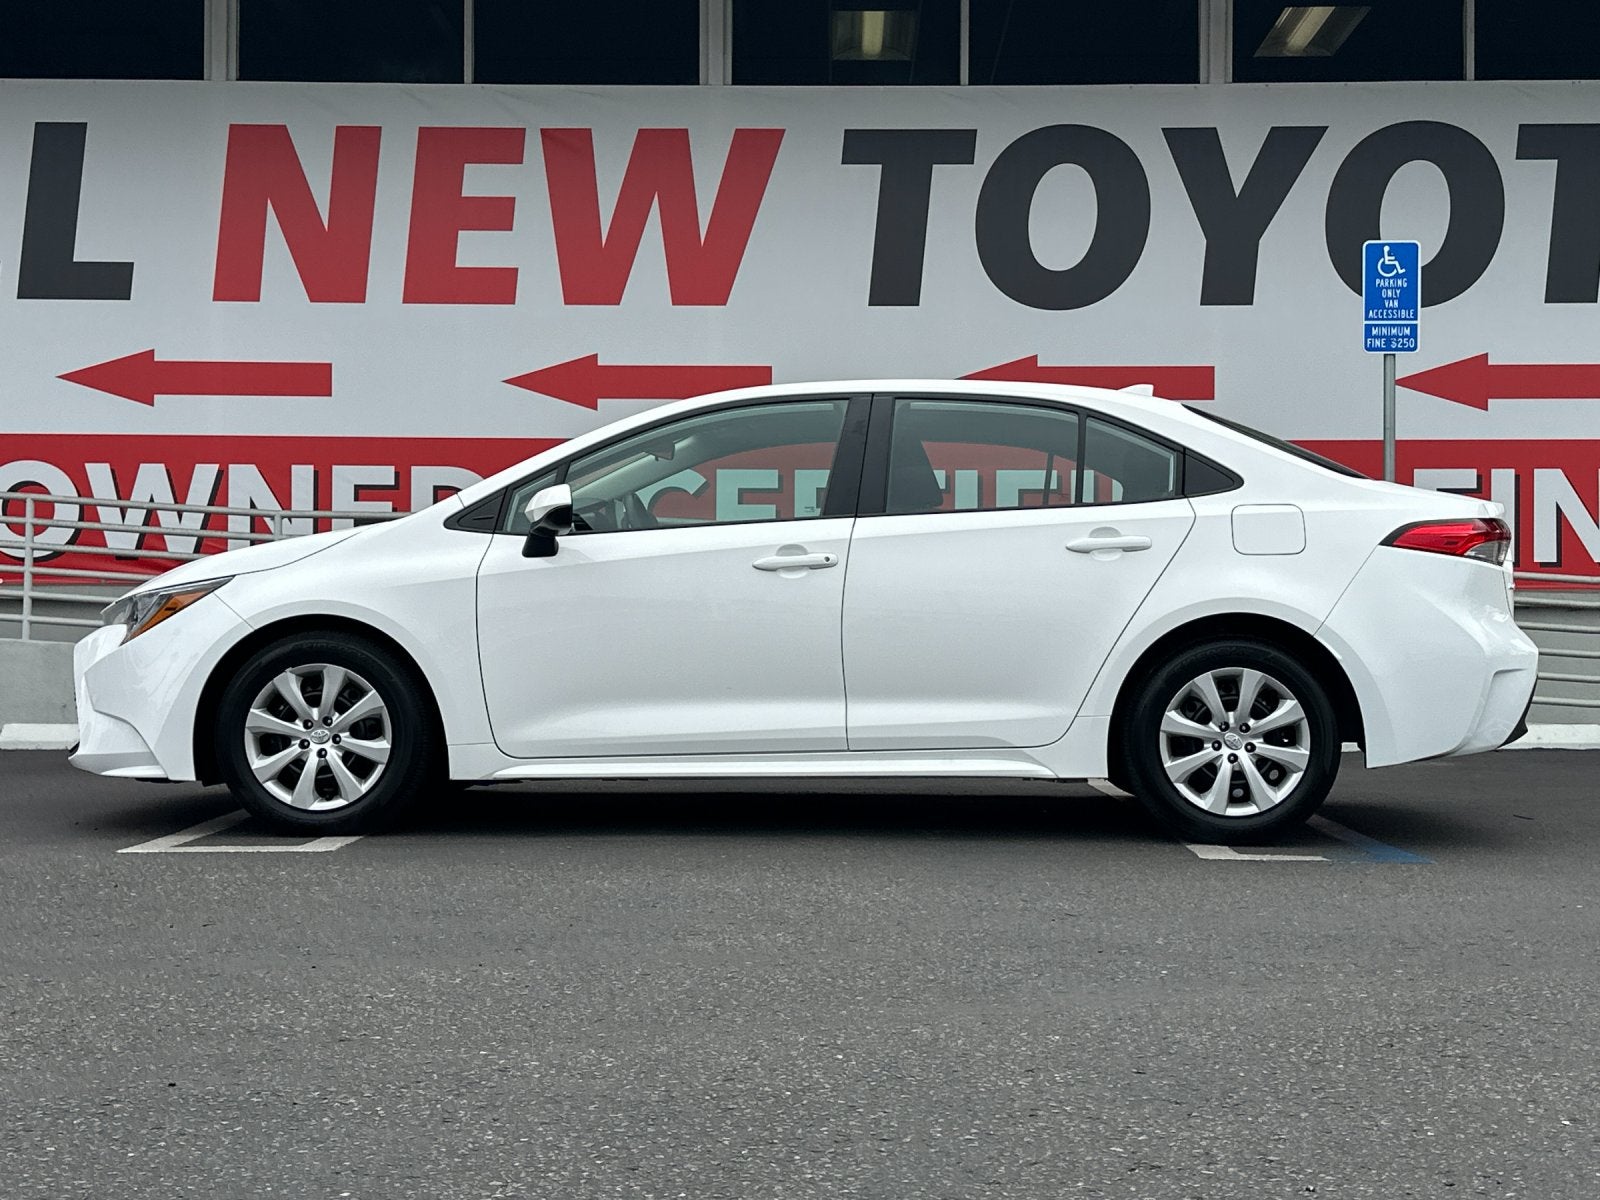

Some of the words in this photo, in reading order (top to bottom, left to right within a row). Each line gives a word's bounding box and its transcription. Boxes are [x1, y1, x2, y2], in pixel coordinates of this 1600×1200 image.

[213, 124, 786, 306] NEW
[1375, 278, 1408, 288] PARKING
[1381, 288, 1401, 298] ONLY
[1384, 299, 1399, 308] VAN
[1368, 309, 1415, 319] ACCESSIBLE
[1371, 326, 1411, 337] MINIMUM
[1366, 338, 1387, 348] FINE
